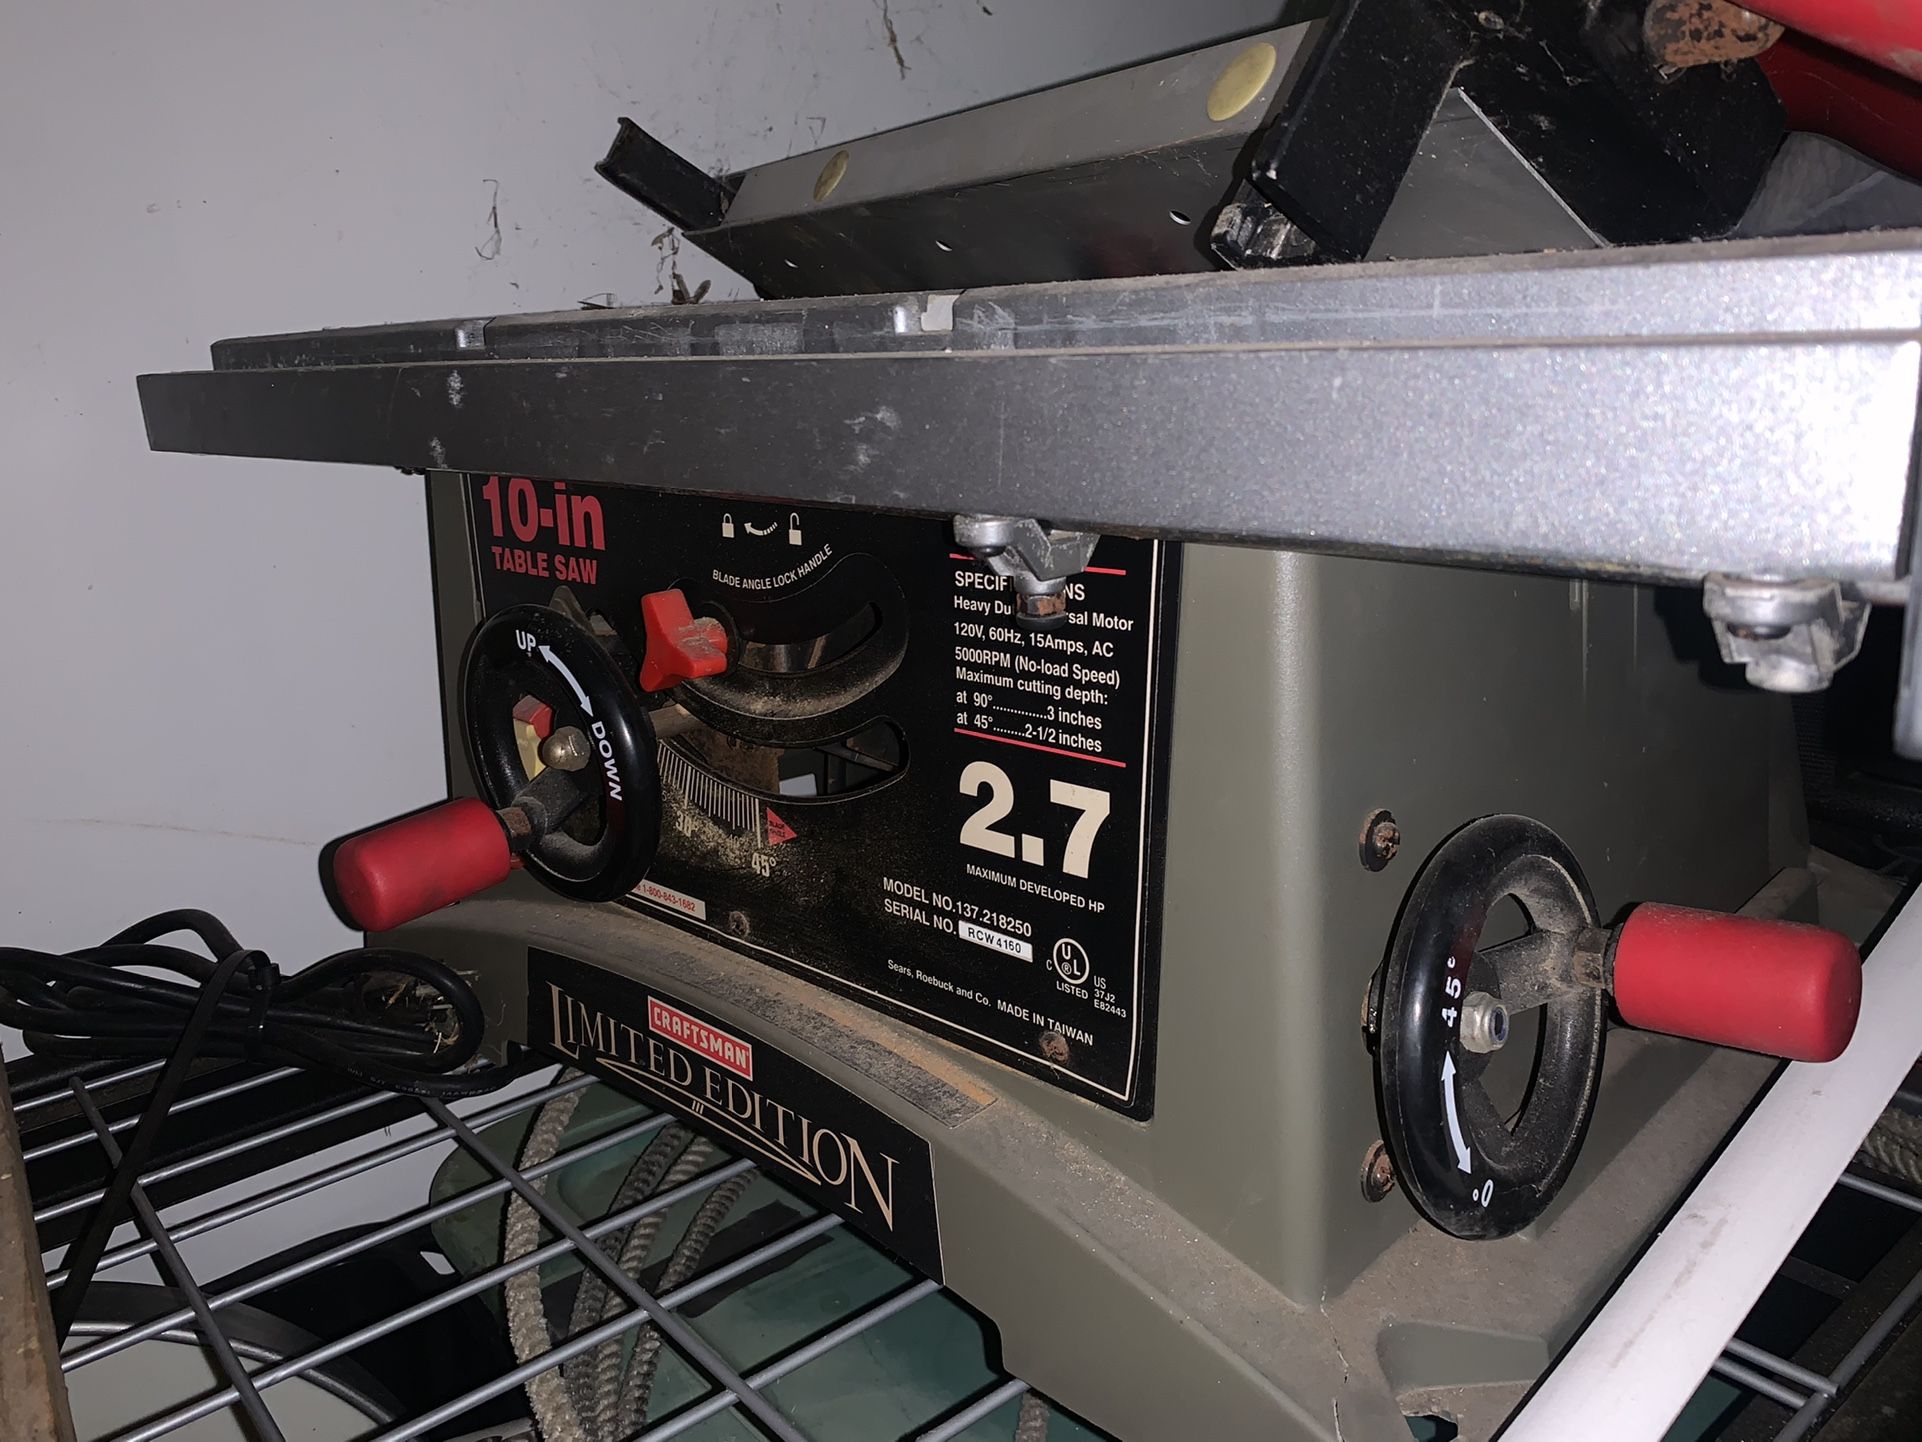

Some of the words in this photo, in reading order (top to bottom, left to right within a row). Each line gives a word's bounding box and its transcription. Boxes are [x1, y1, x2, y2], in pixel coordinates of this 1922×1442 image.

[482, 475, 606, 551] 10-in
[491, 546, 550, 577] TABLE
[554, 554, 598, 585] SAW
[712, 569, 741, 588] BLADE
[742, 577, 772, 590] ANGLE
[773, 569, 798, 588] LOCK
[797, 543, 833, 578] HANDLE
[954, 595, 991, 616] Heavy
[1092, 612, 1134, 632] Motor
[515, 629, 537, 652] UP
[953, 621, 986, 641] 120V,
[988, 626, 1025, 647] 60Hz,
[1029, 632, 1088, 656] 15Amps,
[1091, 640, 1114, 658] AC
[954, 646, 1011, 669] 5000RPM
[1014, 654, 1069, 678] (No-load
[1072, 667, 1121, 690] Speed)
[956, 667, 1014, 689] Maximum
[1017, 675, 1062, 700] cutting
[1065, 685, 1109, 706] depth:
[956, 690, 968, 705] at
[1058, 707, 1103, 730] inches
[956, 711, 968, 726] at
[1058, 730, 1103, 753] inches
[591, 721, 623, 801] DOWN
[959, 761, 1111, 879] 2.7
[883, 877, 930, 904] MODEL
[966, 863, 1017, 888] MAXIMUM
[1019, 879, 1086, 909] DEVELOPED
[1088, 899, 1105, 914] HP
[884, 898, 930, 926] SERIAL
[933, 914, 957, 935] NO.
[1056, 980, 1089, 1000] LISTED
[1093, 975, 1107, 990] US
[887, 959, 914, 979] Sears,
[916, 969, 954, 993] Roebuck
[956, 984, 973, 1000] and
[975, 992, 992, 1007] Co.
[997, 999, 1030, 1021] MADE
[1032, 1012, 1045, 1027] IN
[1047, 1017, 1094, 1047] TAIWAN
[1093, 998, 1127, 1018] E82443
[653, 1006, 747, 1069] CRAFTSMAN
[546, 981, 694, 1087] LIMITED
[703, 1066, 900, 1233] EDITION
